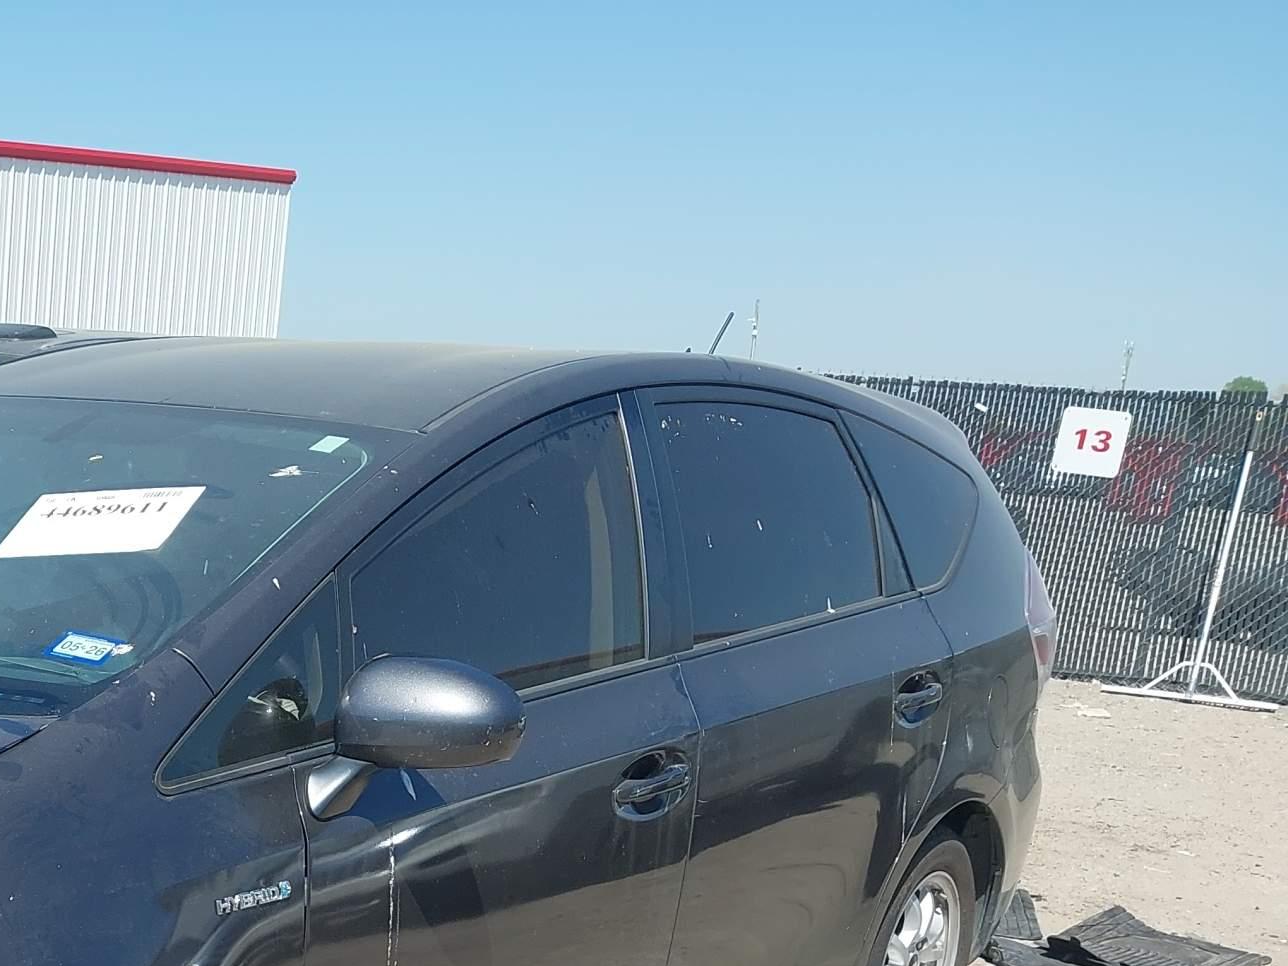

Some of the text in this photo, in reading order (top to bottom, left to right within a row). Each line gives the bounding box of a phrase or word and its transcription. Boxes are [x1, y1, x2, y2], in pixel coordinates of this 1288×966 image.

[1074, 428, 1113, 453] 13
[40, 501, 169, 519] 44689611
[215, 886, 281, 916] HYBRID
